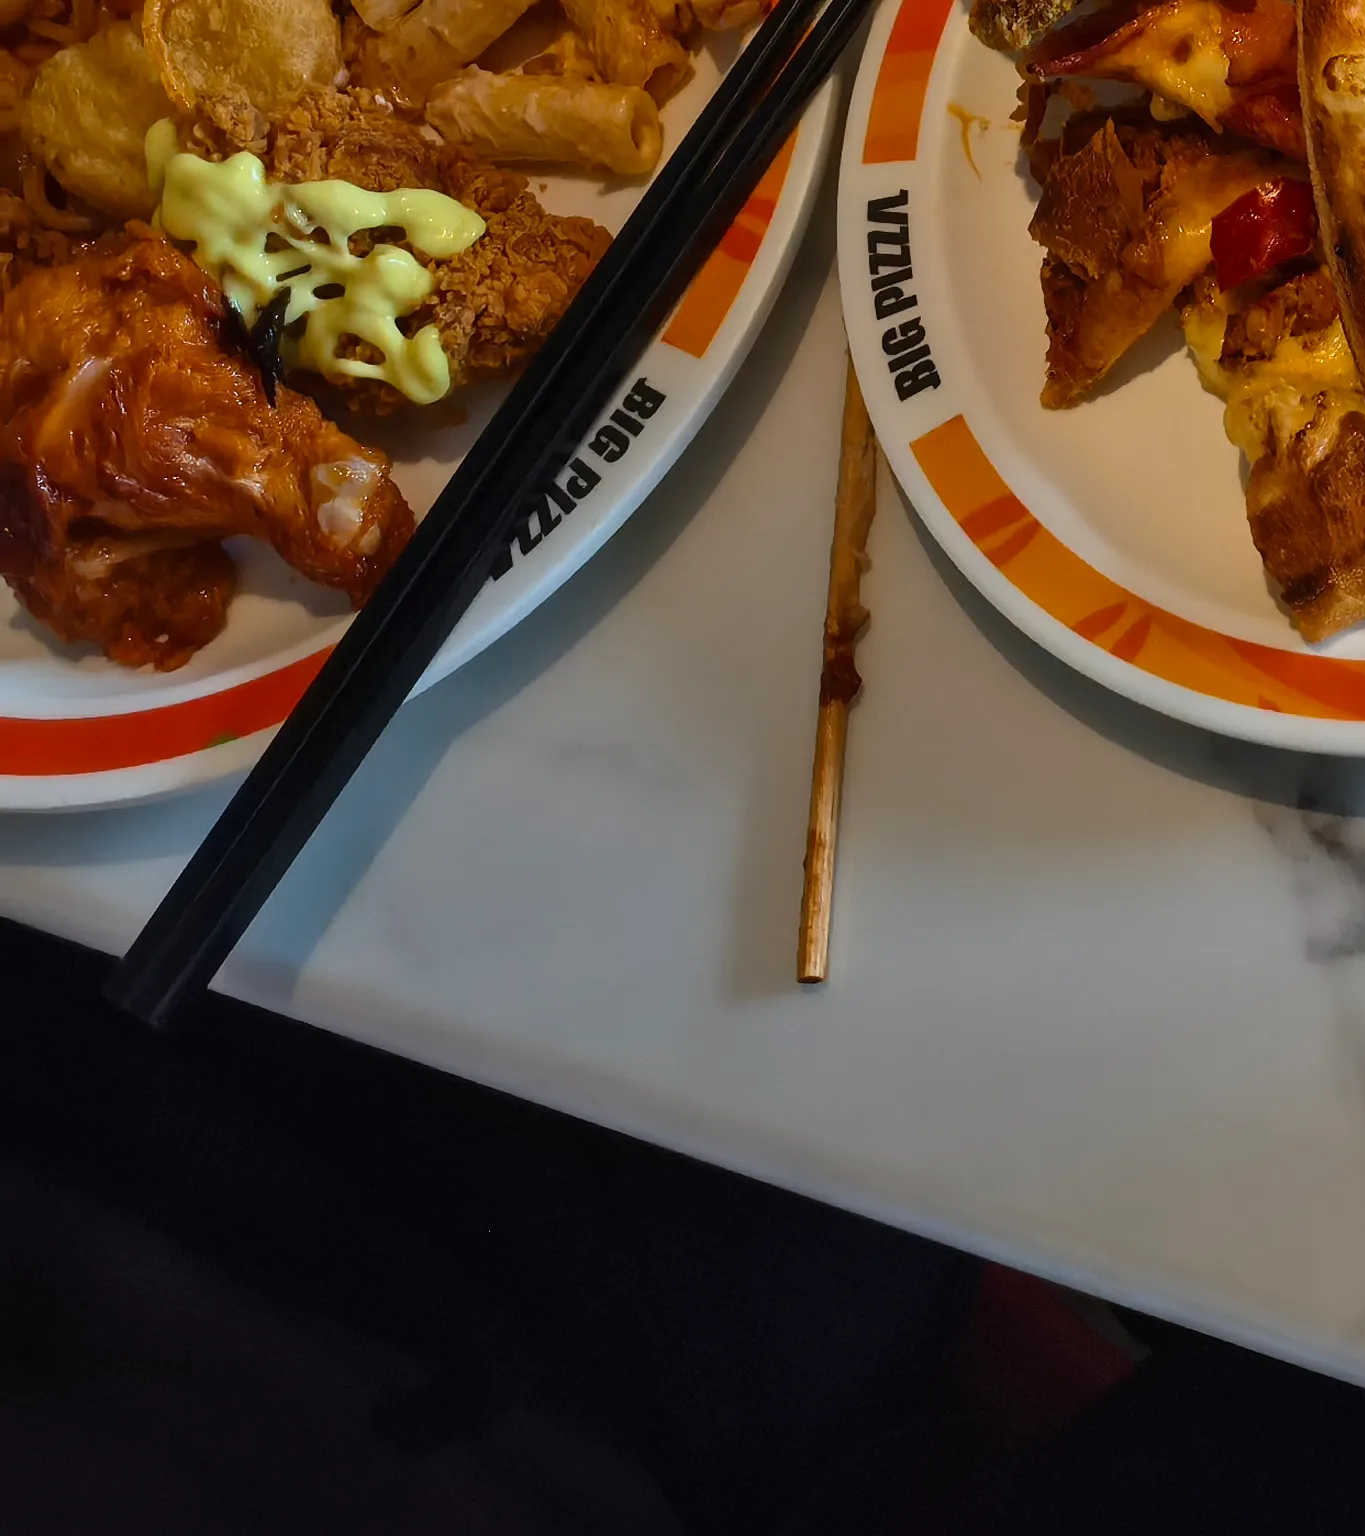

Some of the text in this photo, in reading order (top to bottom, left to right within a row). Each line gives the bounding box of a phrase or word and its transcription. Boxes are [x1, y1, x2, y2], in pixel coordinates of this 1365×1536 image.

[867, 189, 941, 402] BIG PIZZA
[588, 377, 667, 463] BIG
